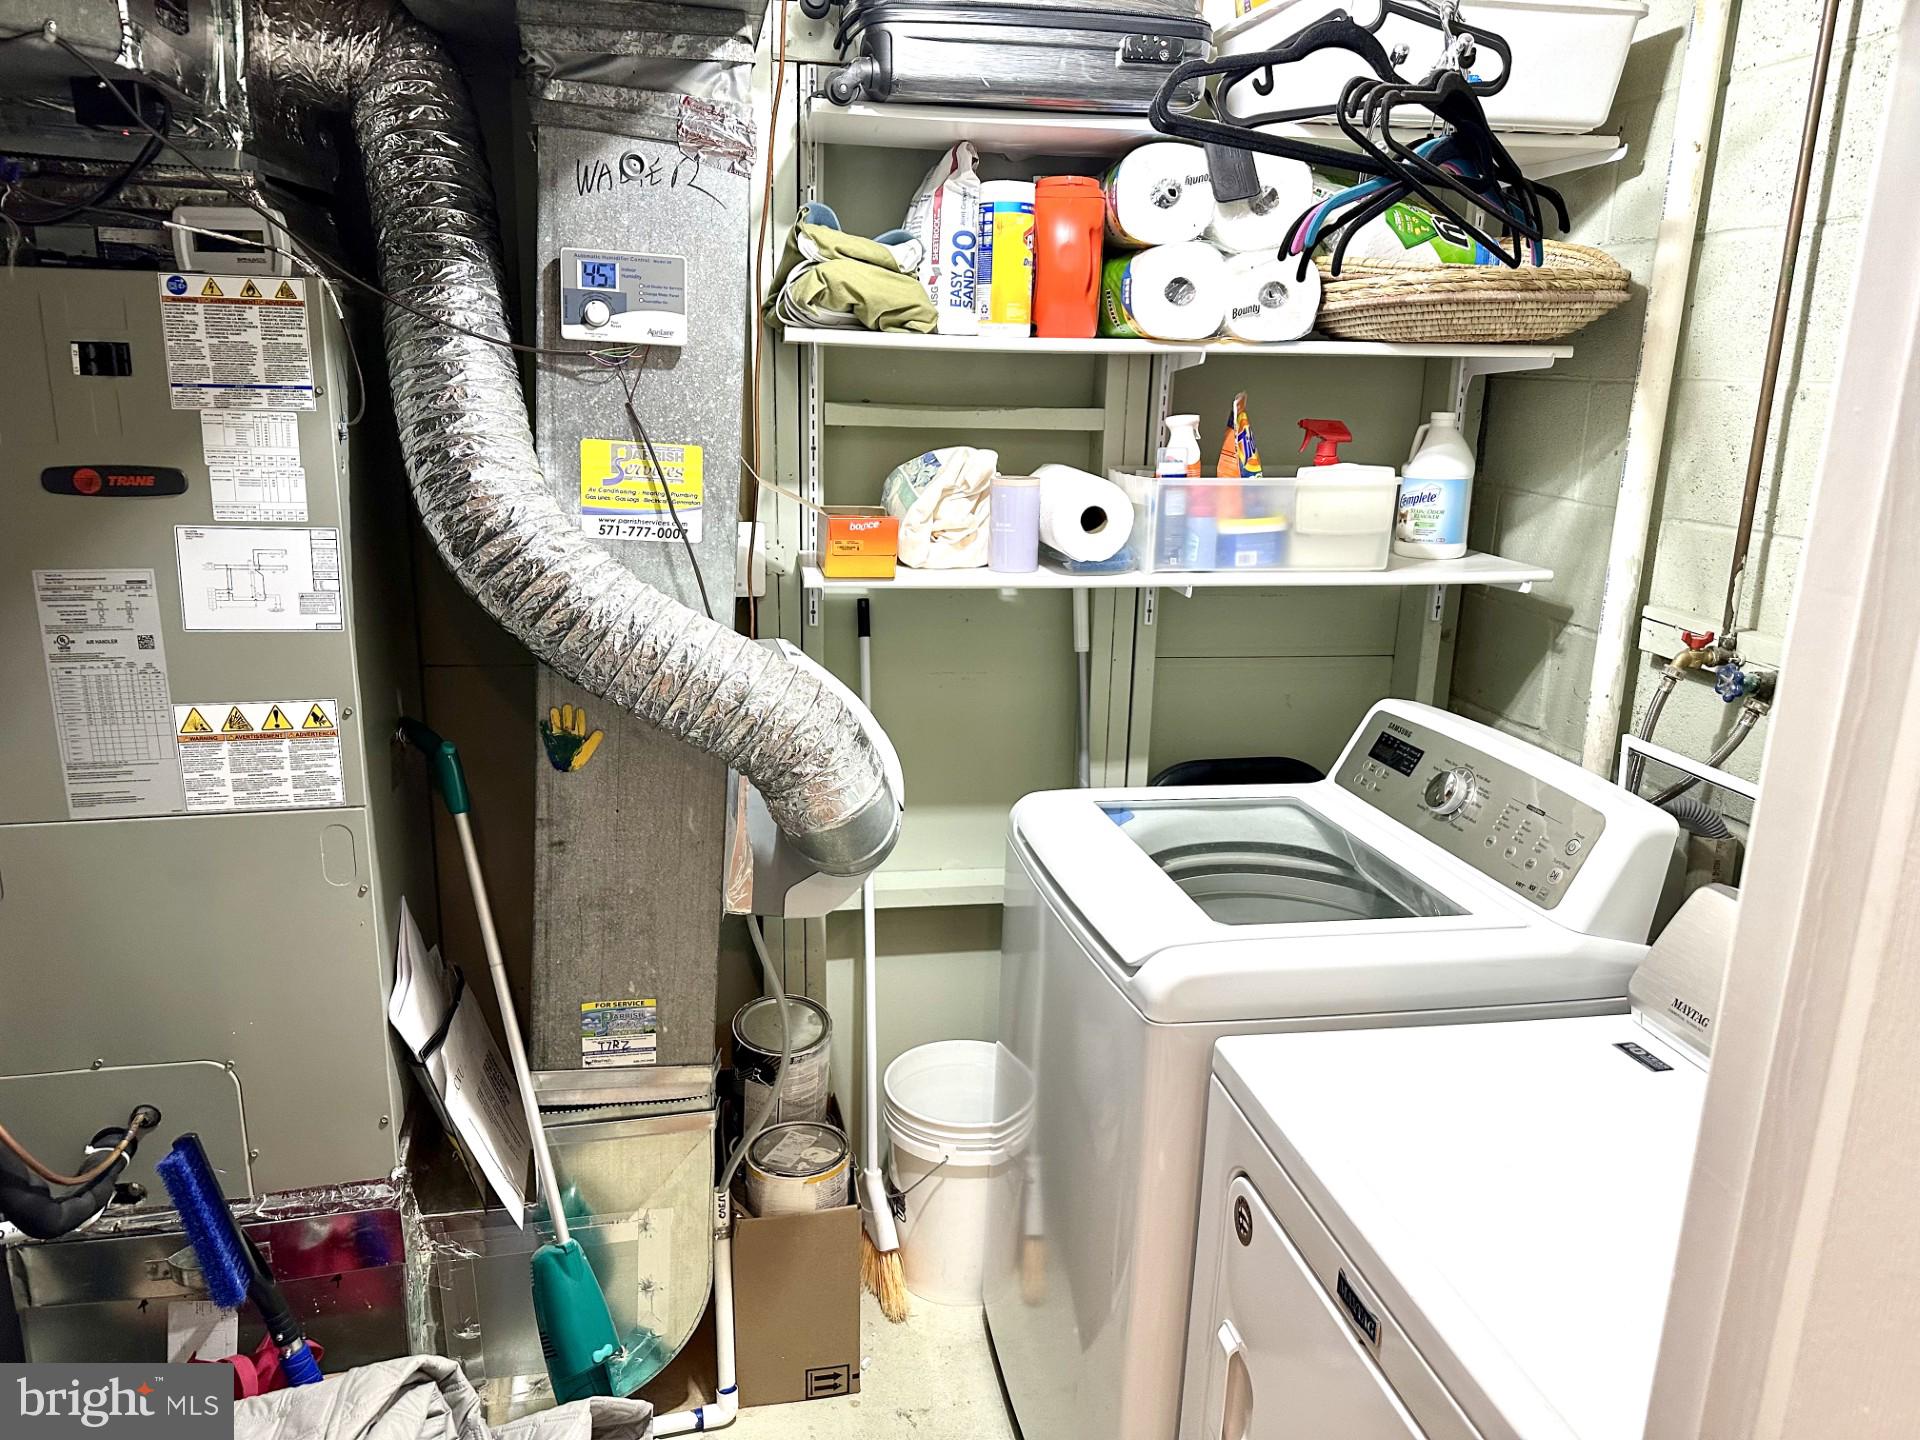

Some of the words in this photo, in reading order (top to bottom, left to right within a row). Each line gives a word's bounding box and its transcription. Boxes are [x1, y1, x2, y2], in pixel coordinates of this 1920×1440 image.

[1184, 173, 1211, 185] ounty
[932, 217, 942, 262] SHEETROCK
[951, 230, 977, 269] 20
[583, 263, 608, 288] 45
[929, 286, 939, 305] USG
[950, 271, 963, 308] EASY
[963, 268, 976, 309] SAND
[1232, 303, 1261, 319] Bounty
[107, 475, 156, 487] TRANE
[598, 487, 637, 495] Conditioning
[642, 489, 665, 498] Heating
[671, 491, 698, 500] Plumbing
[598, 517, 688, 527] www.parrishservices.cm
[849, 520, 880, 531] bounce
[234, 732, 284, 741] AVERTISSEMENT
[295, 730, 337, 738] ADVERTENCIA
[1387, 722, 1413, 738] SAMSUNG
[612, 1000, 645, 1008] SERVICE
[1671, 998, 1710, 1028] MAYTAG
[1340, 1280, 1376, 1338] MAYTAG
